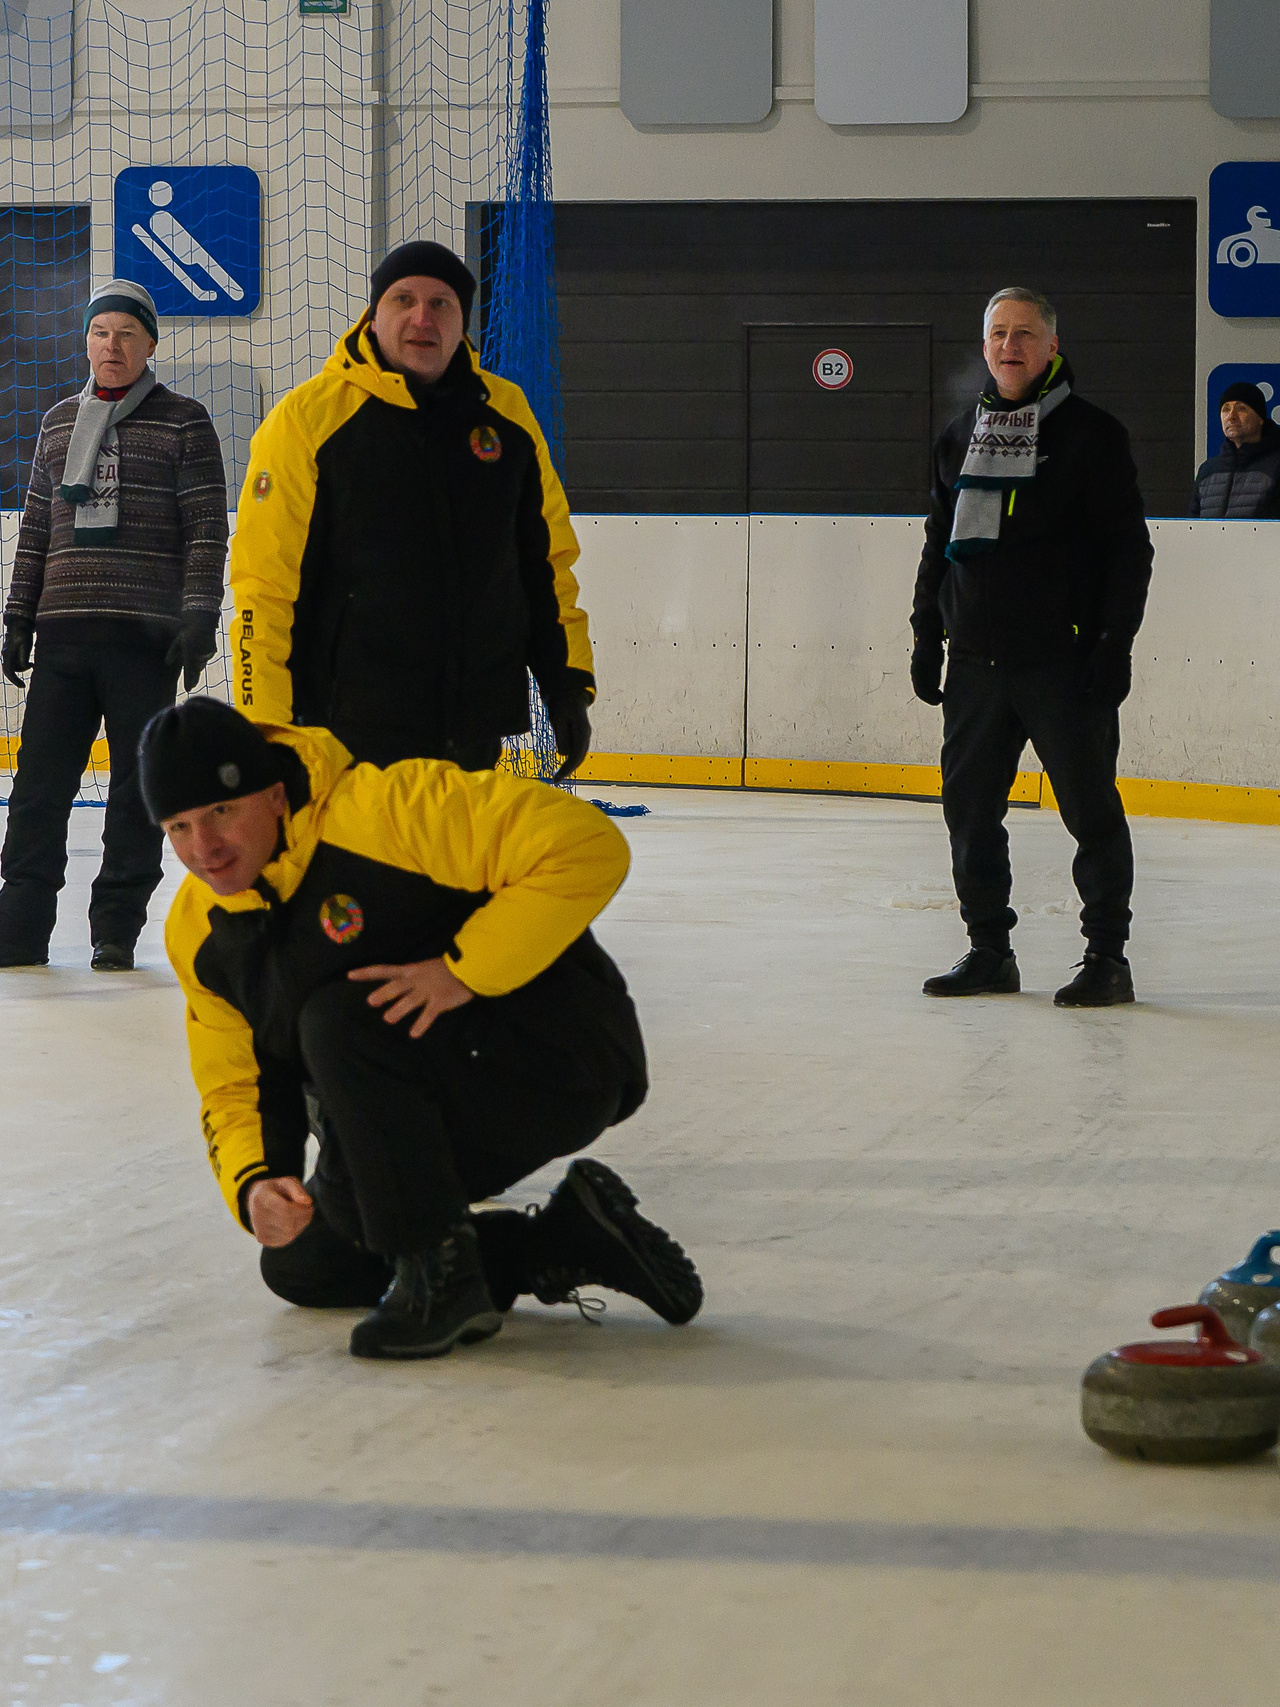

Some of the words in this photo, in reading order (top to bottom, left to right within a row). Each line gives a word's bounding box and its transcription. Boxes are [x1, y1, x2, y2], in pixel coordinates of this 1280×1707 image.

[981, 411, 1036, 428] ДИНЫЕ
[96, 464, 117, 482] ЕД
[240, 609, 254, 706] BELARUS
